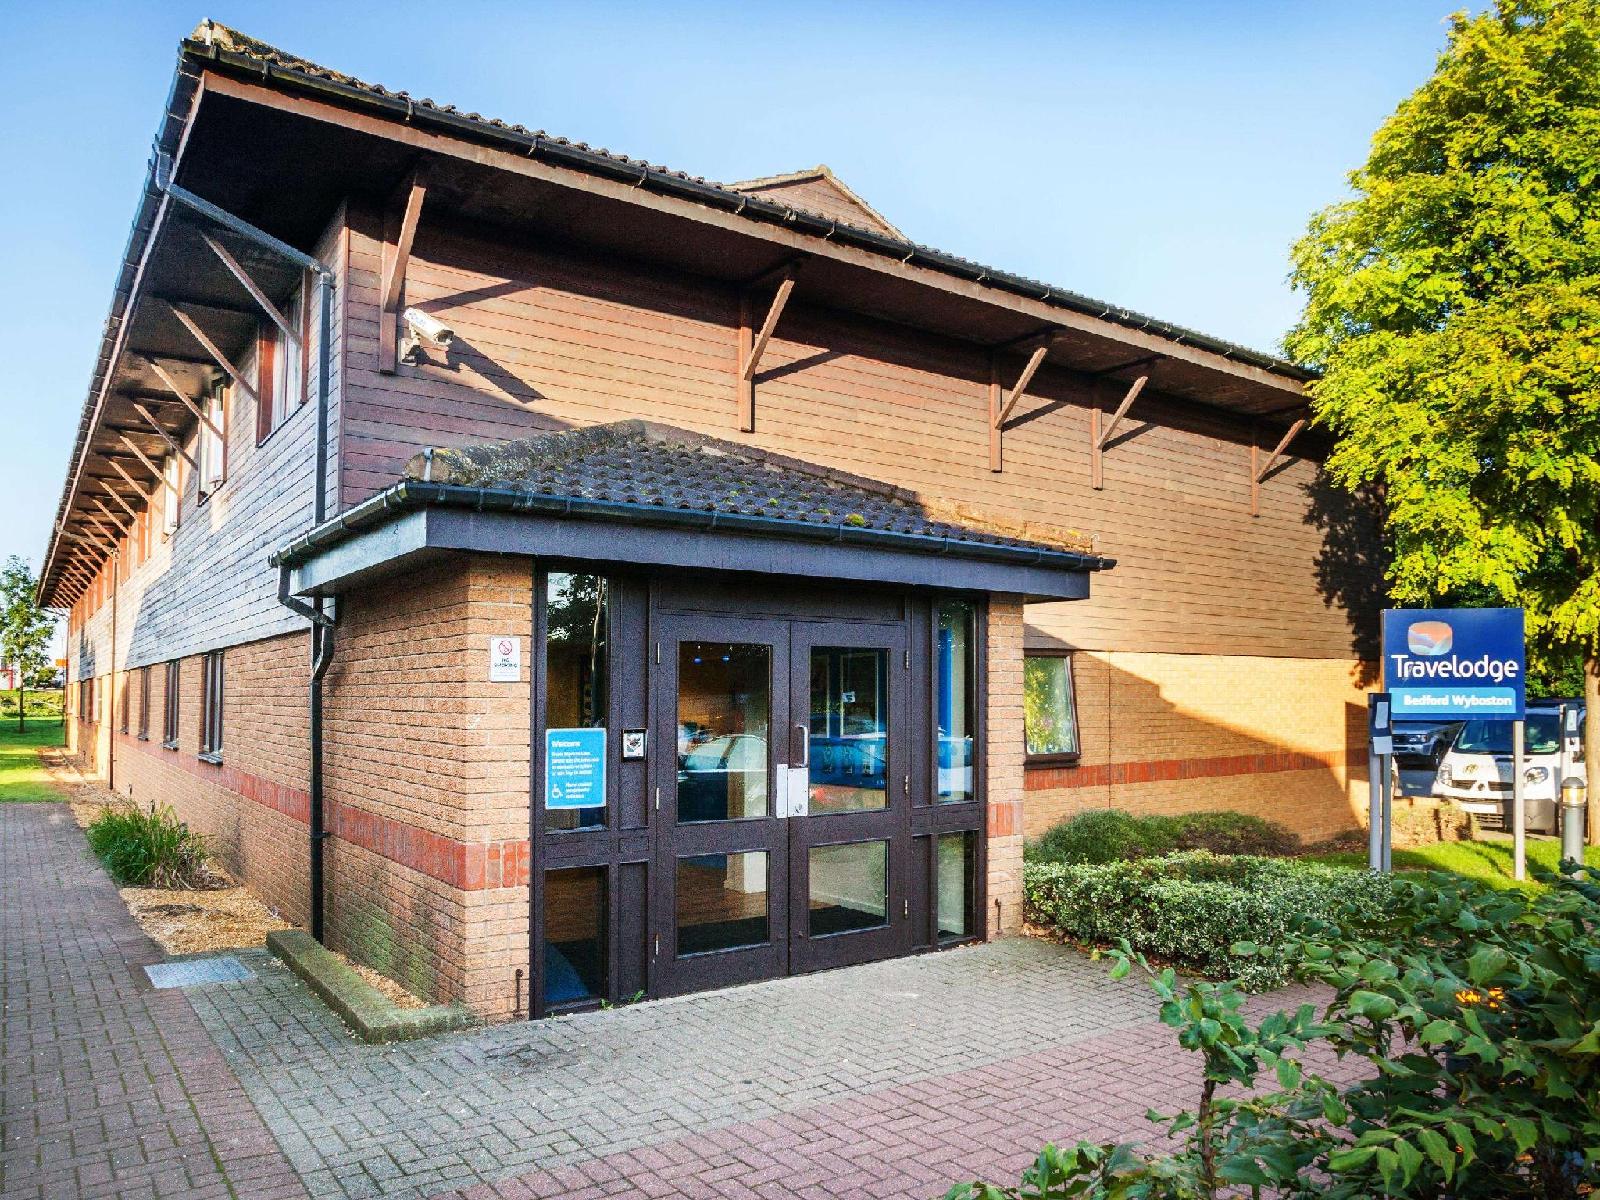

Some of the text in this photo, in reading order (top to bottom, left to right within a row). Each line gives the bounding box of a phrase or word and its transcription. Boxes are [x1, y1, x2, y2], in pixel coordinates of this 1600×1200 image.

[1391, 655, 1519, 682] Travelodge
[1404, 695, 1512, 709] Bedford Wyboston
